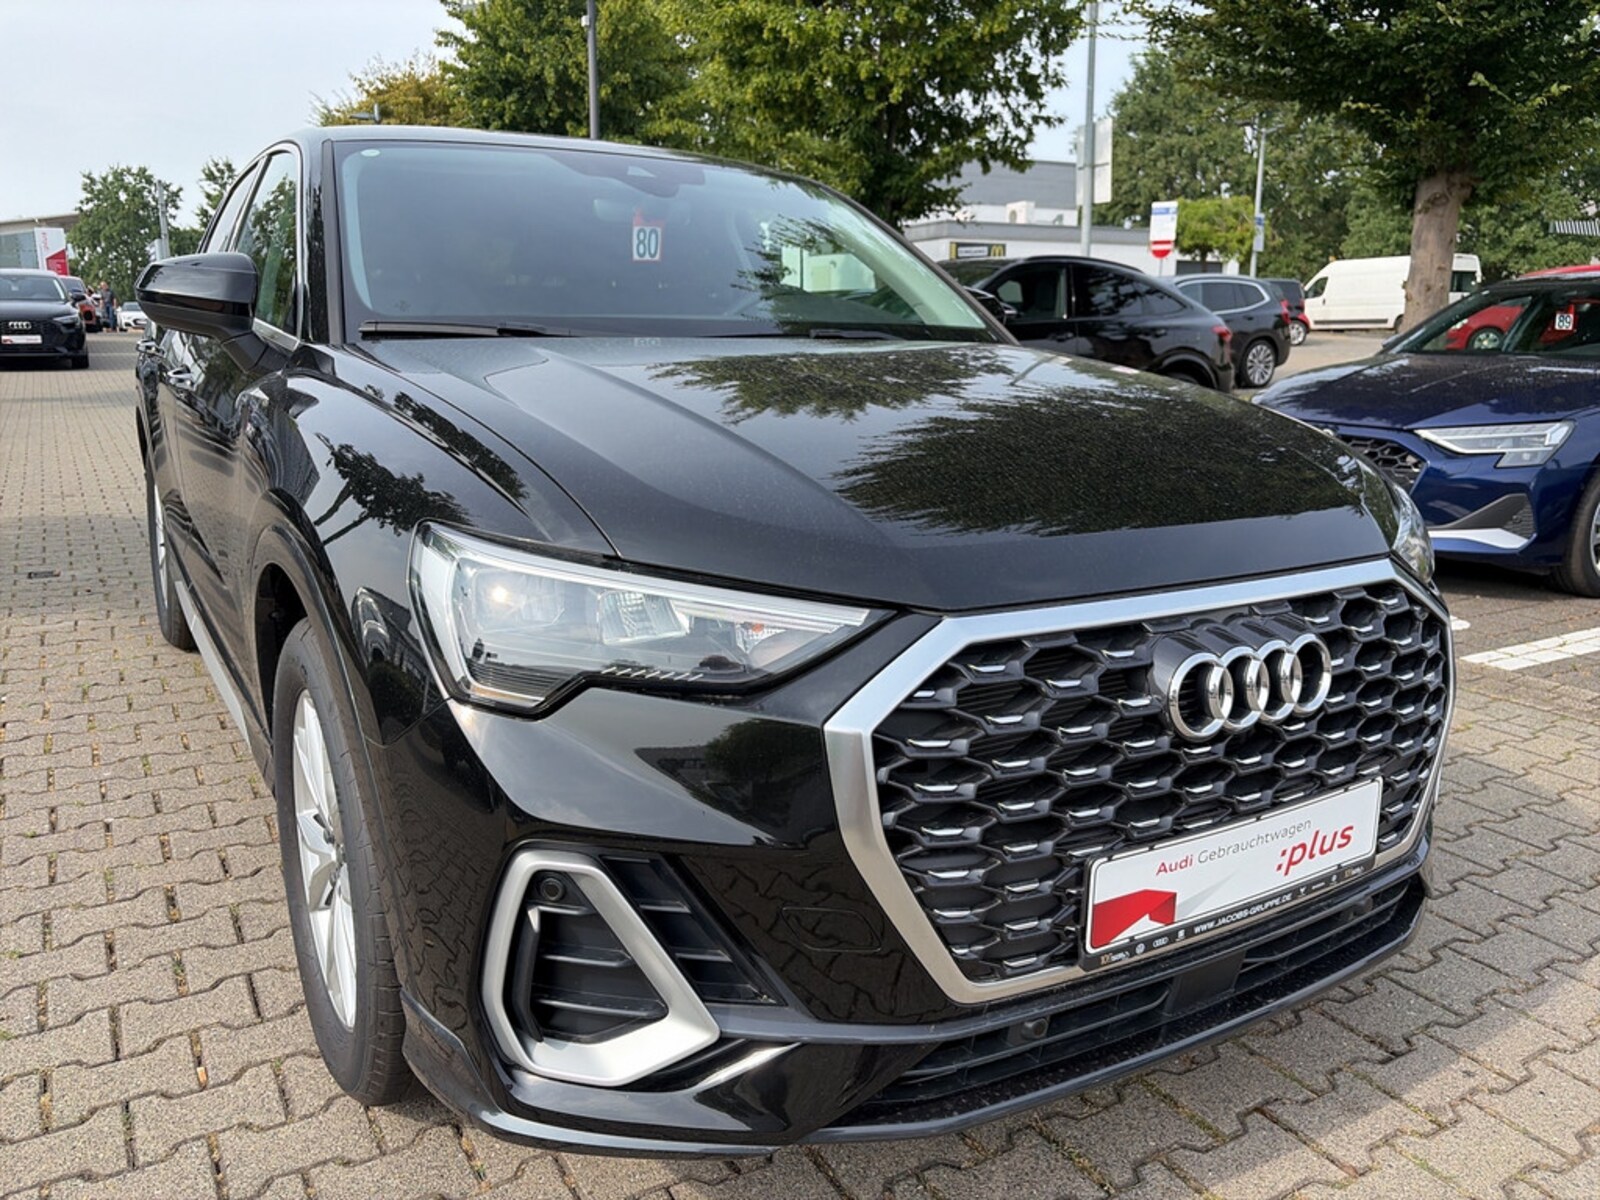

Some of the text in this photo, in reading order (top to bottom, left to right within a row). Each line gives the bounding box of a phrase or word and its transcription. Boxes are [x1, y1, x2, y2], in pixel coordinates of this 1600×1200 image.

[636, 227, 659, 259] 80
[1557, 315, 1571, 328] 89
[1156, 818, 1312, 876] Audi Gebrauchtwagen
[1194, 892, 1293, 935] WWW.JACOBS-GRUPPE.DE
